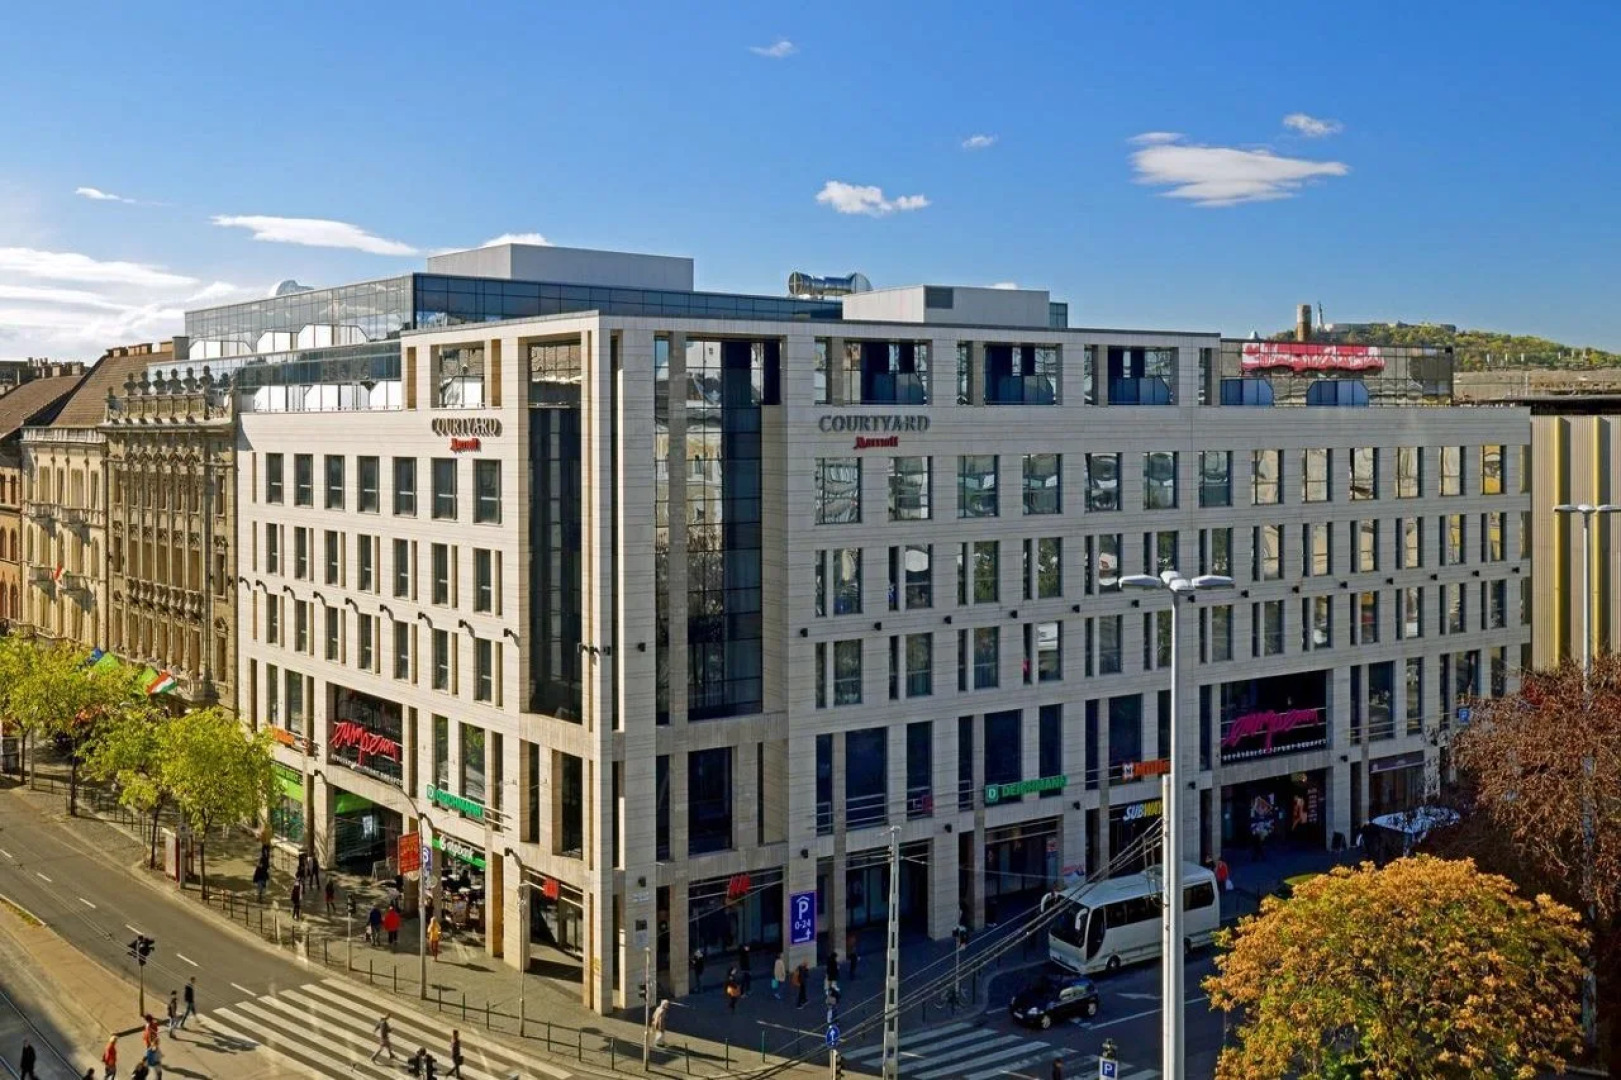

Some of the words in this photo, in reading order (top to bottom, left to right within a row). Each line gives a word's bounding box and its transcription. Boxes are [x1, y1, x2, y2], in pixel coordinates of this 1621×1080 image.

[432, 418, 502, 437] COURTYARD
[819, 415, 930, 432] COURTYARD
[1002, 775, 1068, 797] DEICHMANN
[798, 900, 809, 920] P
[794, 919, 812, 930] 0-24
[1104, 1063, 1113, 1075] P
